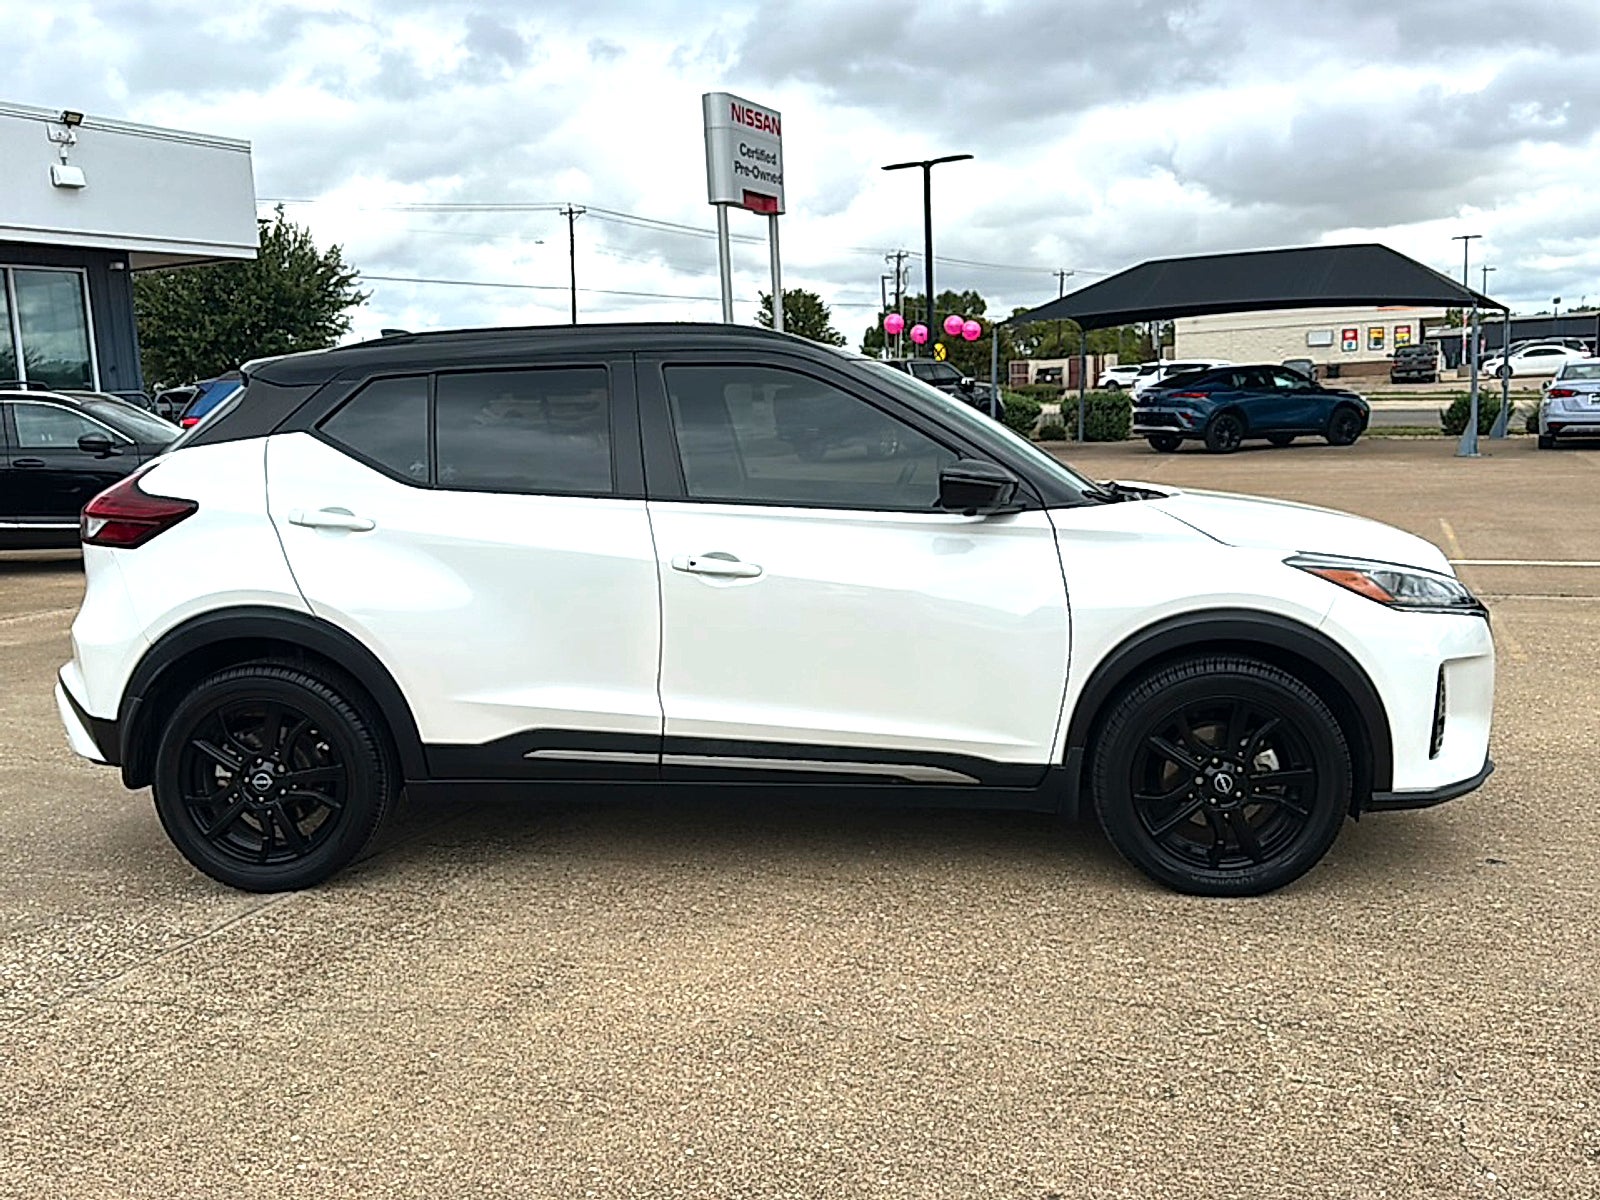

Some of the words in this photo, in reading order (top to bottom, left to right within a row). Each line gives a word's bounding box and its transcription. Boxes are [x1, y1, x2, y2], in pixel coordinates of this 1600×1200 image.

[732, 103, 781, 136] NISSAN
[740, 143, 776, 165] Certified
[735, 161, 783, 185] Pre-Owned
